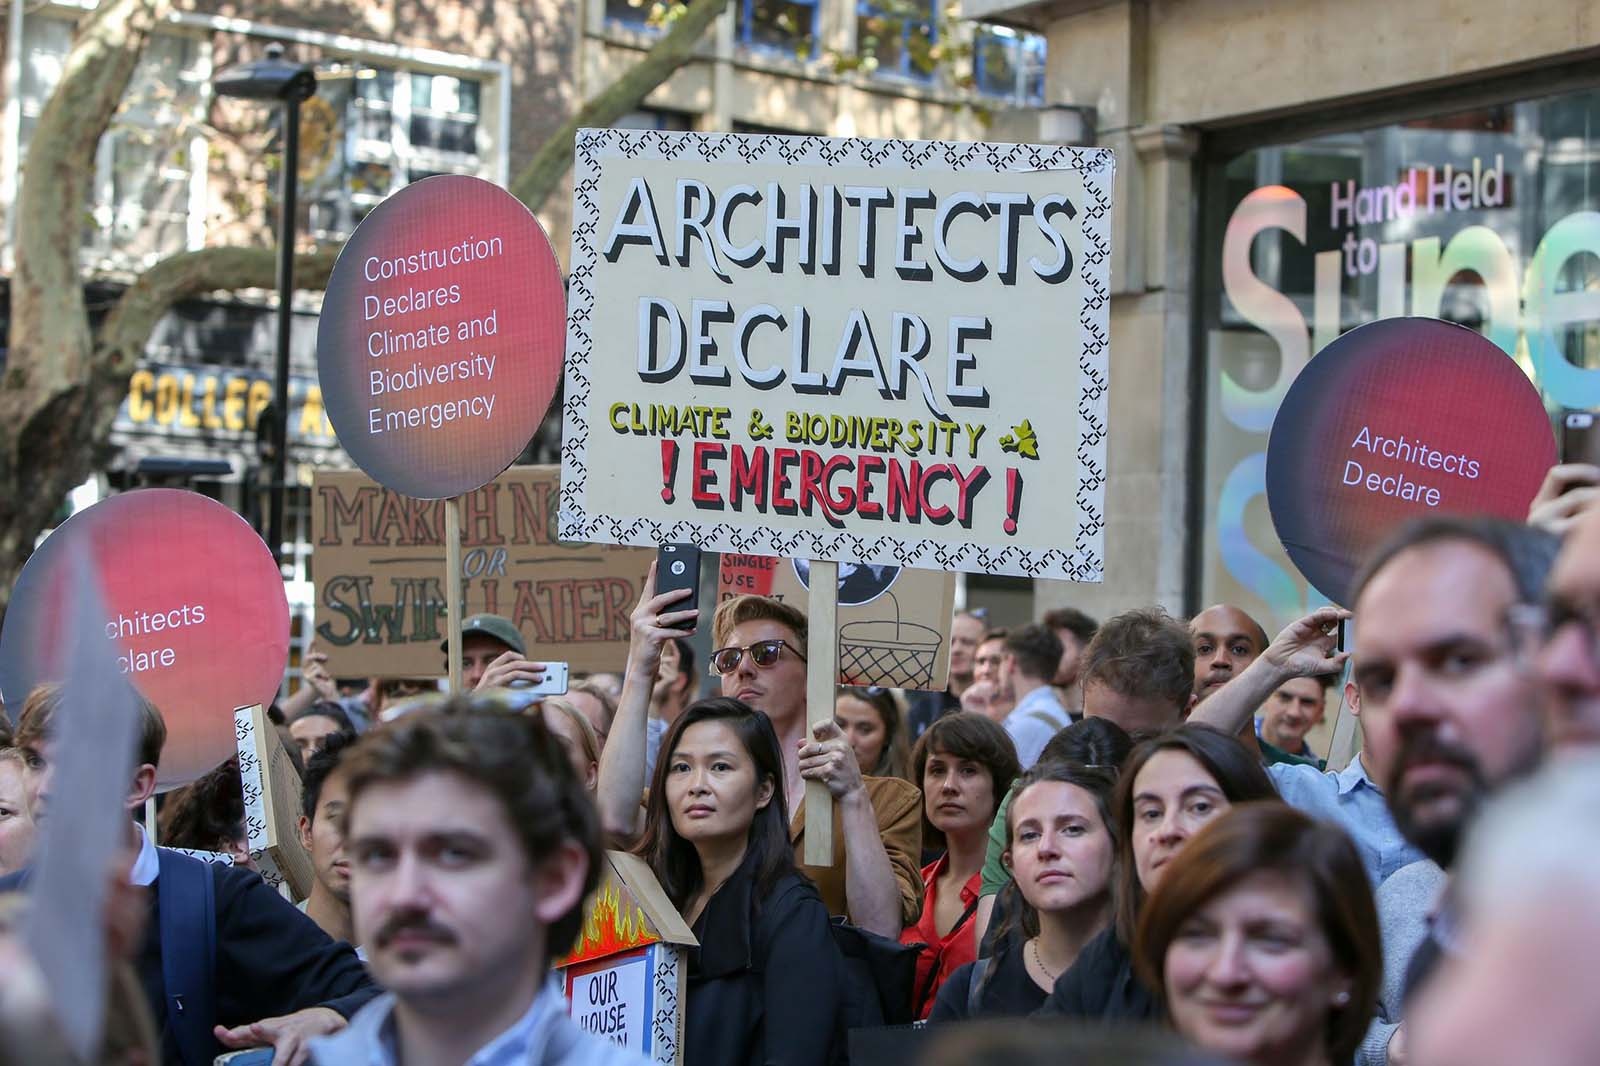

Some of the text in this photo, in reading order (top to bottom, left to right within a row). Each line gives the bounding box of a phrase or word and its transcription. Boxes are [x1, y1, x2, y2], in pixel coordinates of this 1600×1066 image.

[1331, 153, 1504, 229] Hand Held
[603, 177, 1077, 285] ARCHITECTS
[364, 236, 502, 282] Construction
[1343, 232, 1377, 277] to
[364, 284, 461, 320] Declares
[368, 310, 497, 358] Climate and
[370, 352, 496, 396] Biodiversity
[637, 296, 992, 421] DECLARE
[369, 395, 496, 434] Emergency
[609, 402, 987, 458] CLIMATE & BIODIVERSITY
[1352, 426, 1480, 479] Architects
[692, 441, 991, 528] EMERGENCY
[1343, 460, 1441, 506] Declare
[463, 548, 507, 577] OR
[722, 573, 754, 588] USE
[105, 604, 206, 640] chitects
[116, 647, 175, 674] clare
[589, 971, 619, 1006] OUR
